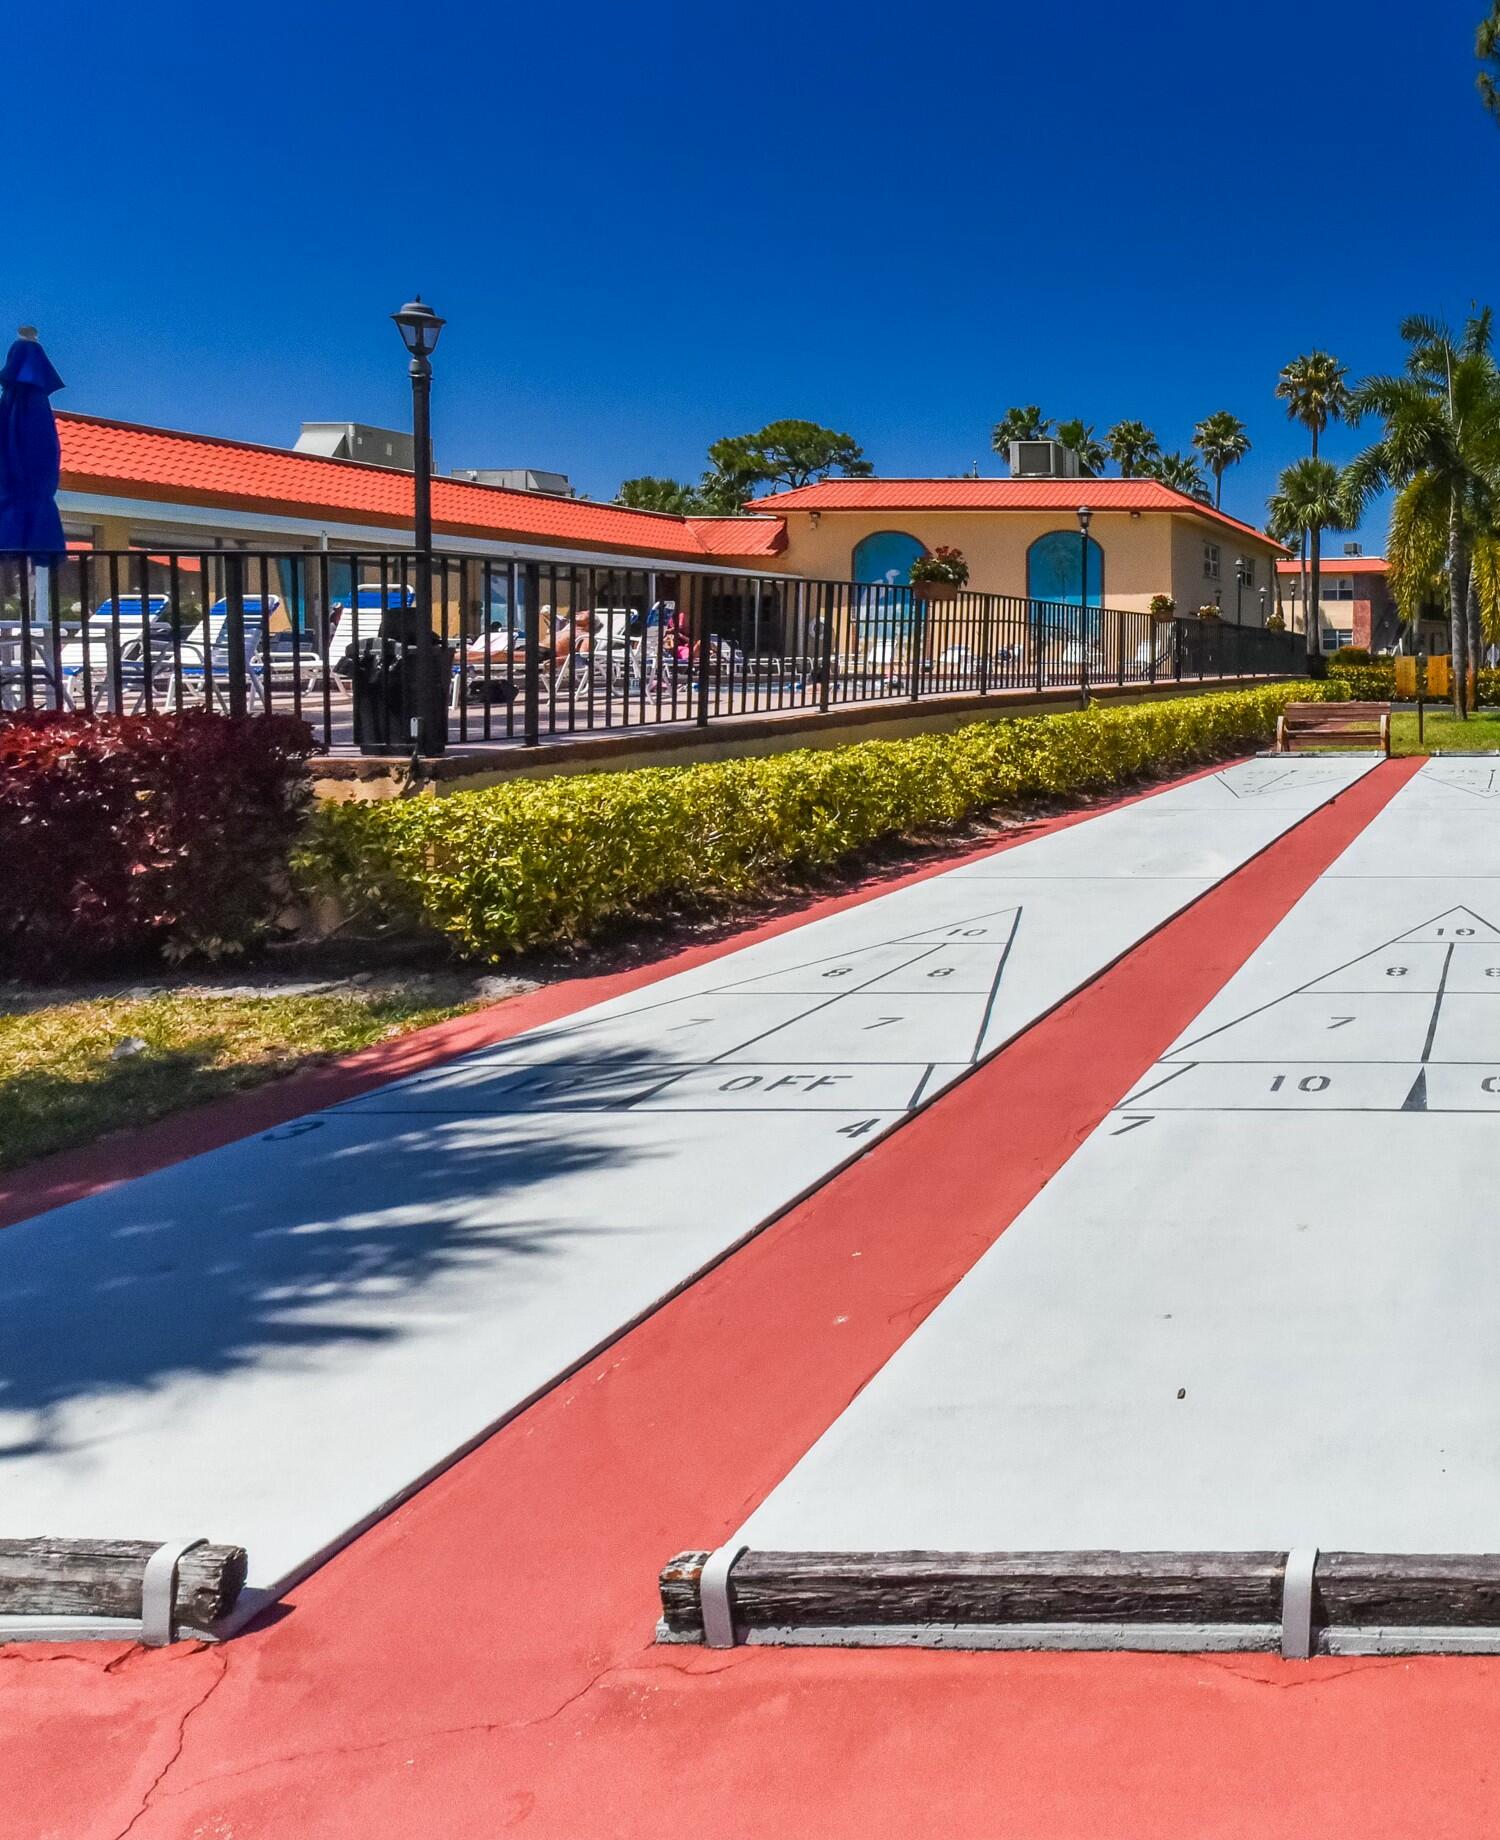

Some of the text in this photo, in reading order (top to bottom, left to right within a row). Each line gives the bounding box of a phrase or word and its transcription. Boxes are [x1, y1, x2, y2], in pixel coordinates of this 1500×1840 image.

[947, 928, 987, 936] 10
[822, 968, 852, 977] 8
[927, 968, 955, 977] 8
[1386, 967, 1408, 976] 8
[666, 1018, 715, 1031] 7
[863, 1017, 904, 1029] 7
[1327, 1017, 1356, 1029] 7
[718, 1075, 853, 1091] OFF
[1270, 1075, 1331, 1092] 10
[262, 1121, 325, 1141] 3
[836, 1119, 878, 1138] 4
[1109, 1116, 1155, 1135] 7
